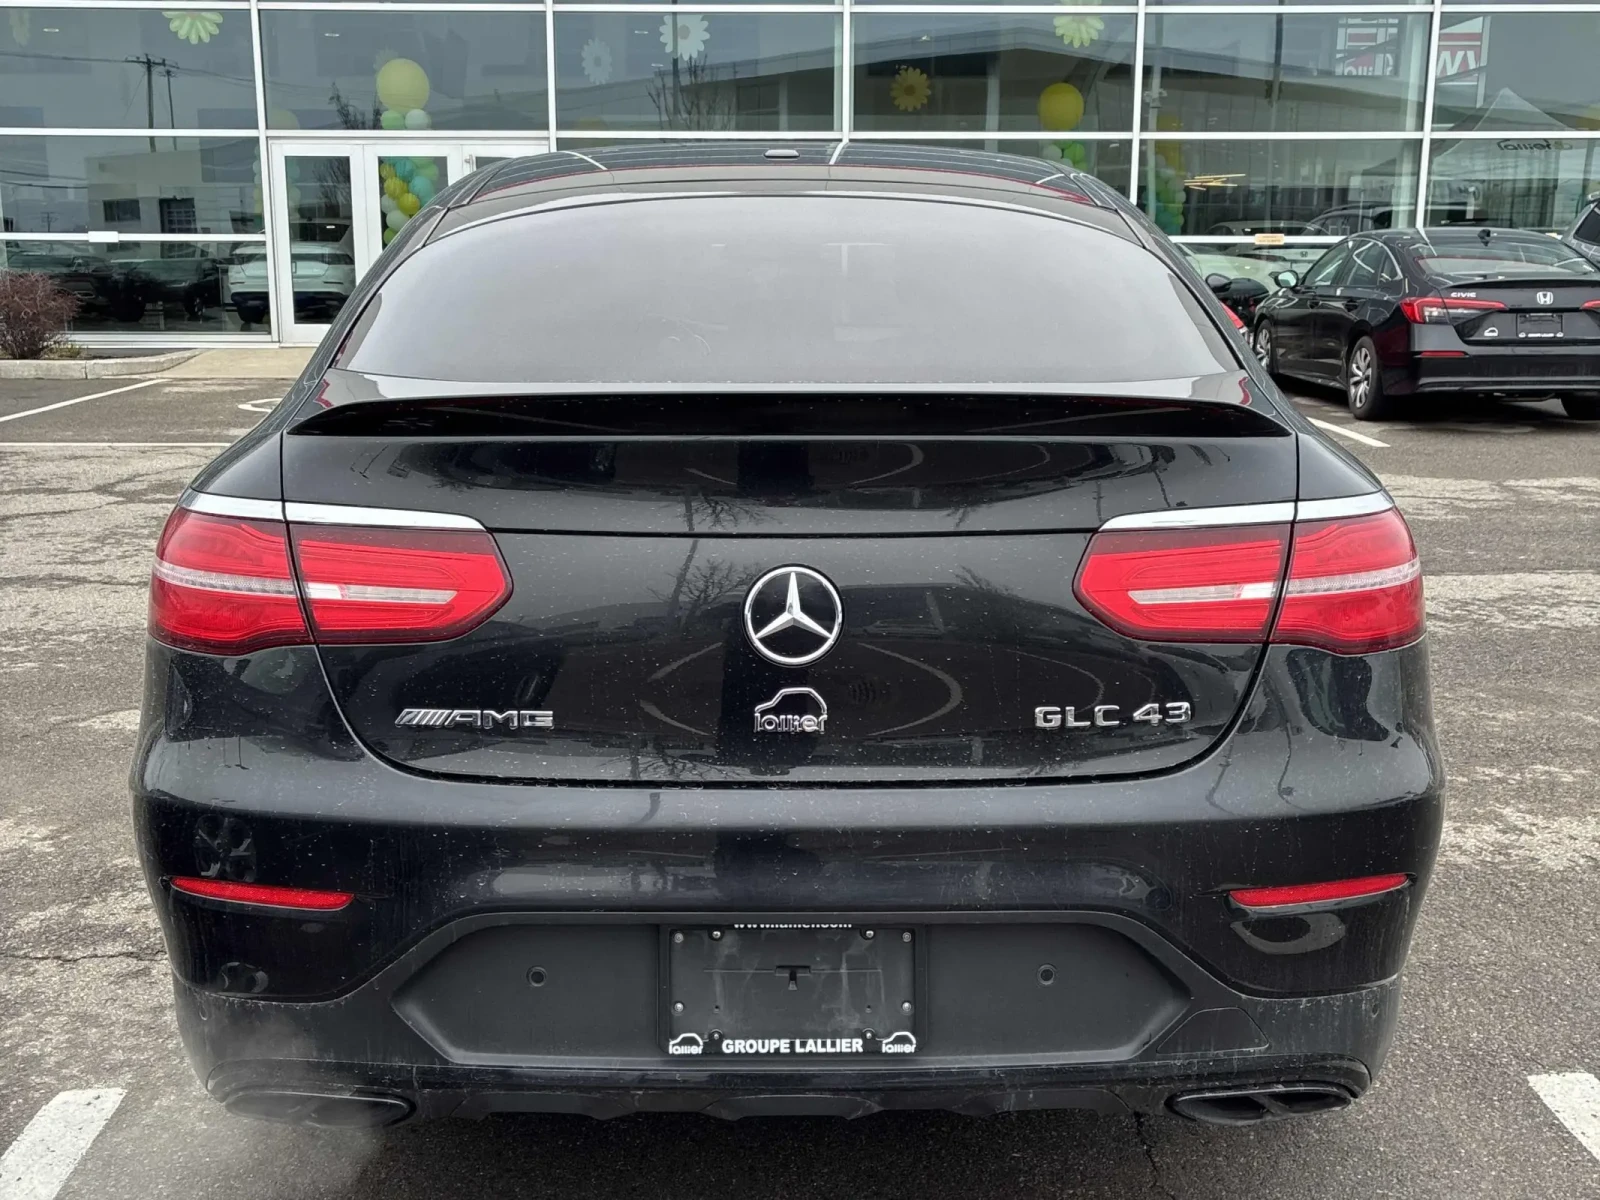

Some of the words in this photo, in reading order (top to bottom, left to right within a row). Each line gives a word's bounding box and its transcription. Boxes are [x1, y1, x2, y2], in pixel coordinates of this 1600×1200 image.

[444, 709, 554, 728] AMG
[1035, 705, 1120, 729] GLC
[1133, 702, 1192, 727] 43
[722, 1039, 791, 1054] GROUPE
[794, 1038, 864, 1054] LALLIER
